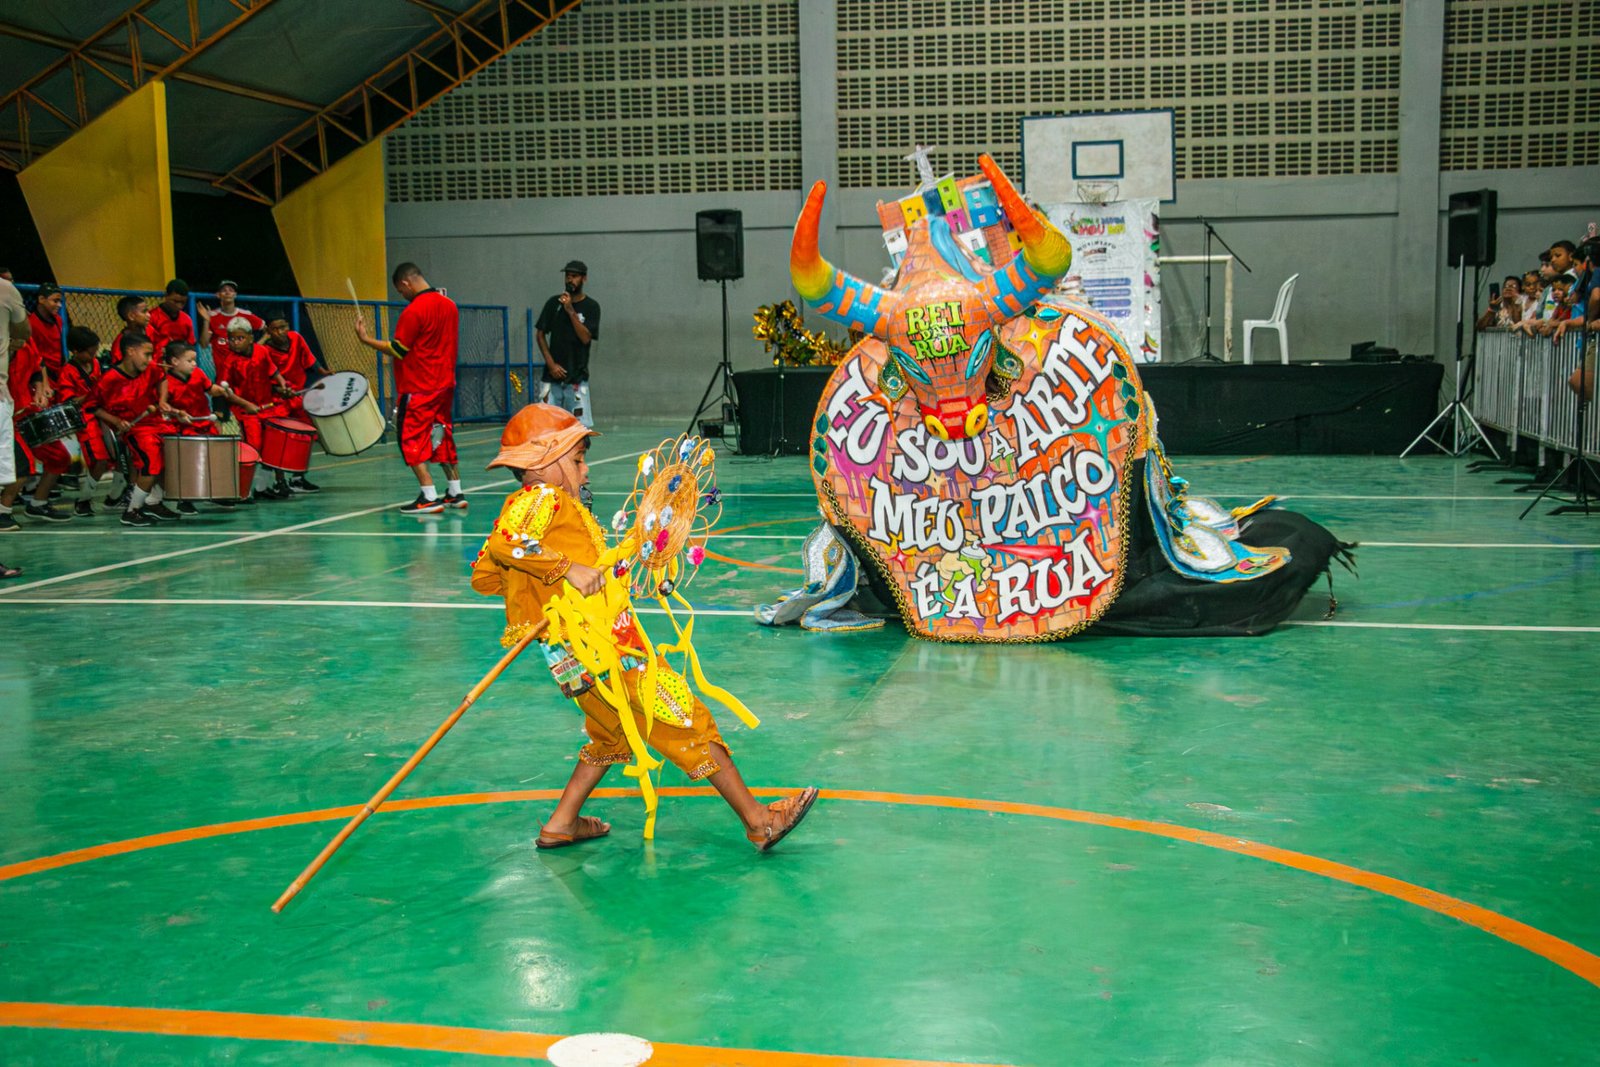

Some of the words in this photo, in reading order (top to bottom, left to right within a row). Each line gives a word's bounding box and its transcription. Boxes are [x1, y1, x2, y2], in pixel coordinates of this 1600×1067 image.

[905, 301, 965, 336] REI
[912, 333, 972, 361] RUA
[921, 324, 946, 341] DA
[827, 356, 896, 466] EU
[892, 422, 987, 484] SOU
[990, 432, 1016, 461] A
[1007, 314, 1120, 462] ARTE
[868, 475, 966, 553] MEU
[973, 449, 1117, 547] PALCO
[912, 562, 943, 619] É
[948, 581, 984, 620] A
[993, 529, 1114, 624] RUA
